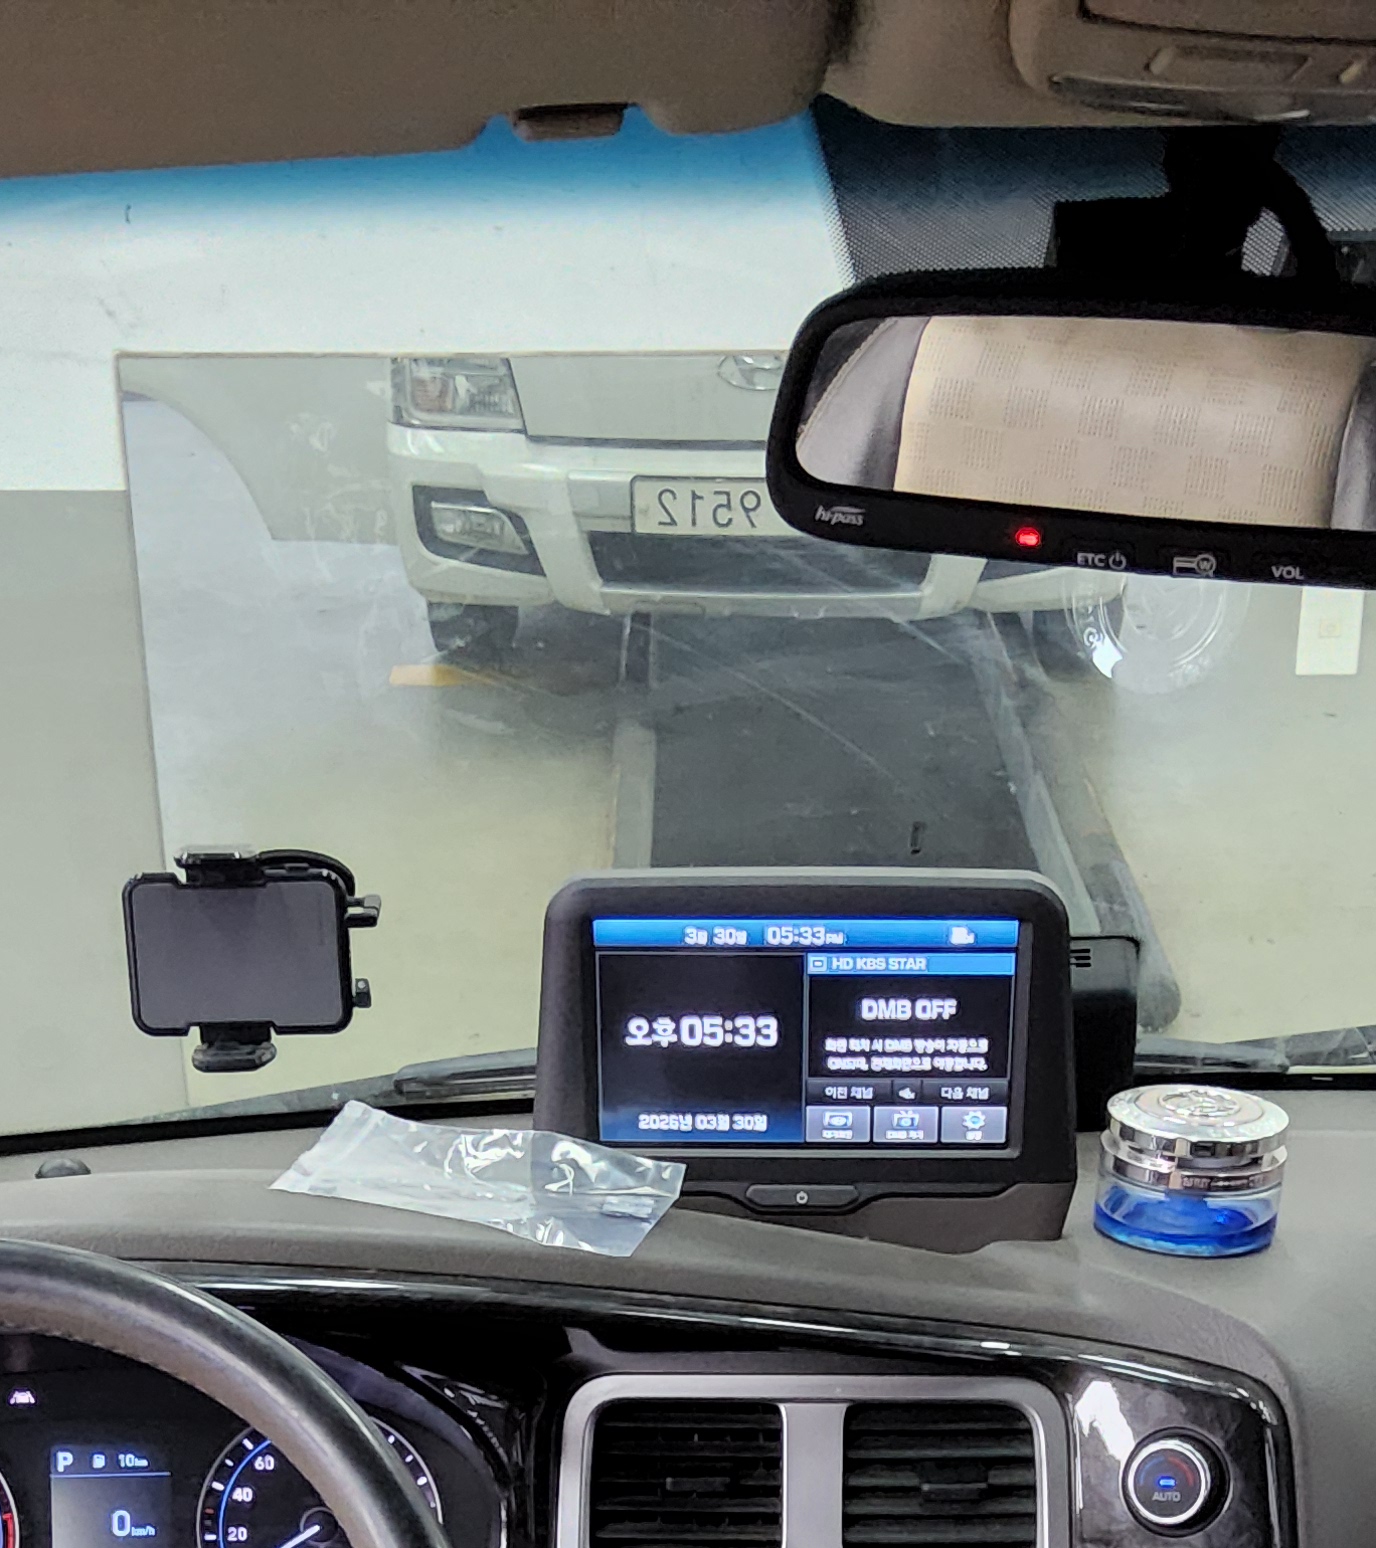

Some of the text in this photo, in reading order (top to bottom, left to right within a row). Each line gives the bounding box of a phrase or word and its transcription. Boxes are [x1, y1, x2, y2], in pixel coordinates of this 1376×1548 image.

[1077, 552, 1106, 568] ETC
[1271, 565, 1305, 580] VOL
[831, 957, 927, 971] HD KBS STAR
[861, 998, 957, 1020] DMB OFF
[56, 1451, 74, 1472] P
[254, 1455, 275, 1471] 60
[231, 1486, 254, 1502] 40
[1152, 1491, 1182, 1502] AUTO
[227, 1526, 249, 1542] 20
